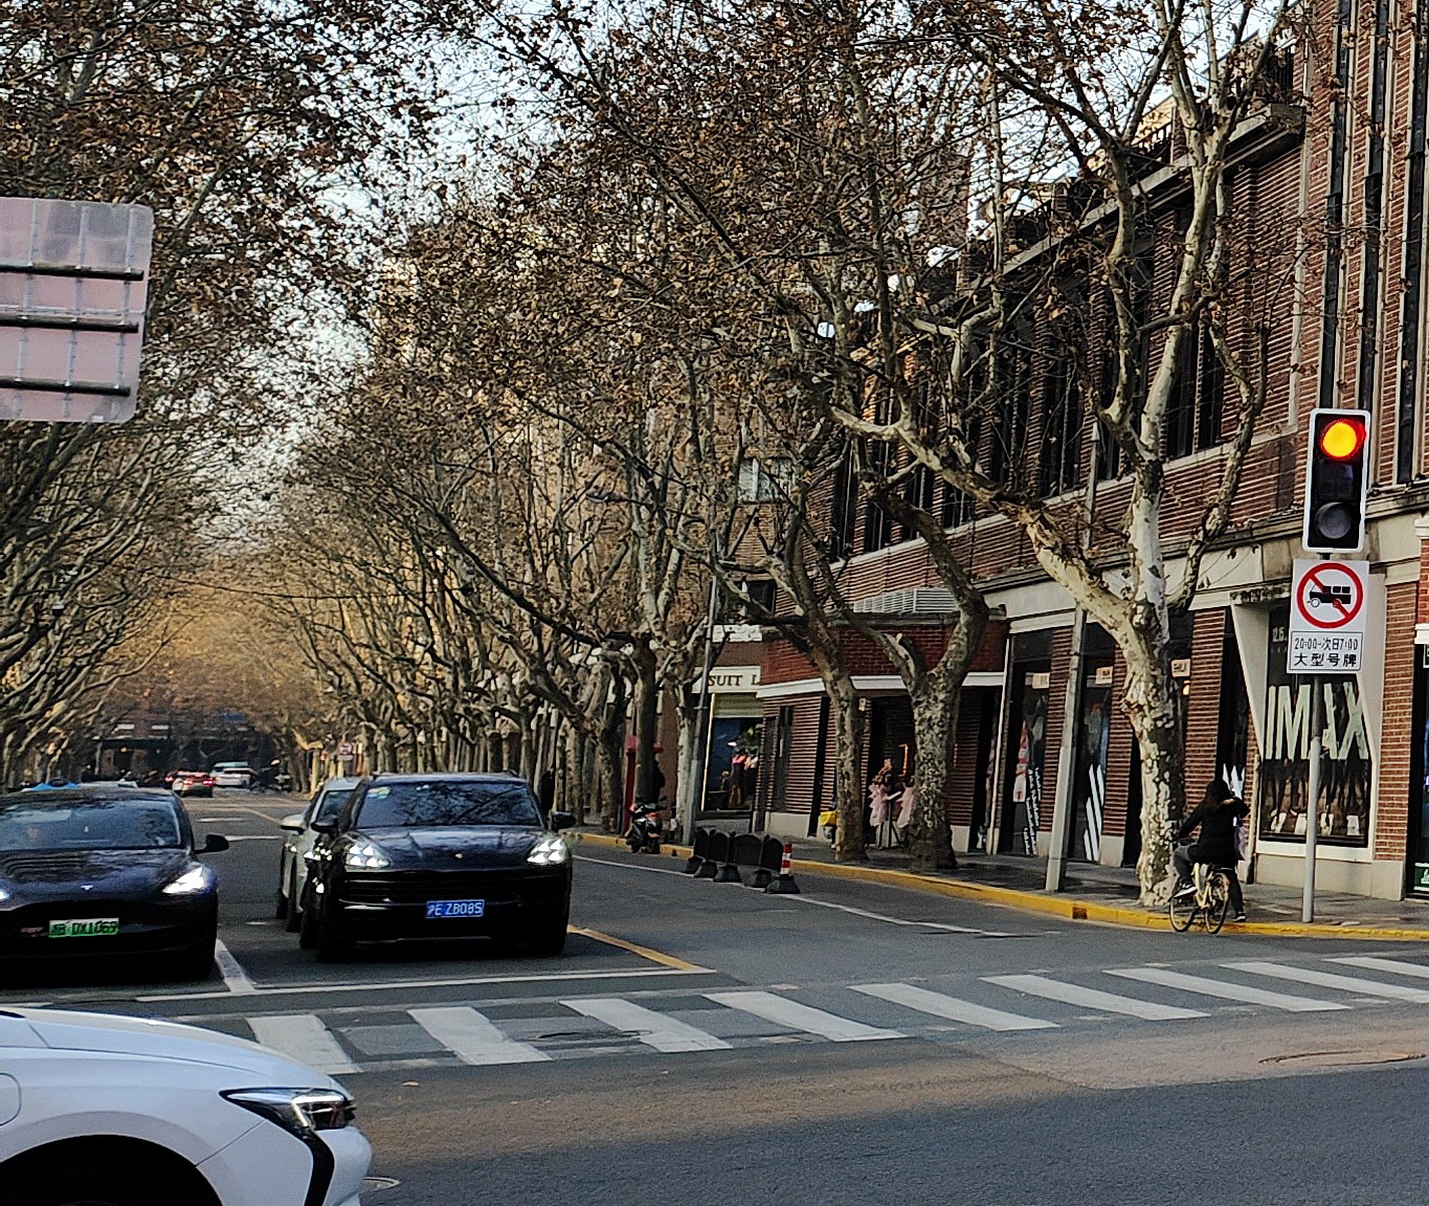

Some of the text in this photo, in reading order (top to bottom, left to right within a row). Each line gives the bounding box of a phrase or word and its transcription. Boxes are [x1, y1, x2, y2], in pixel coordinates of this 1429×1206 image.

[1294, 653, 1357, 667] 大型号牌
[709, 674, 743, 686] SUIT
[1265, 681, 1369, 760] IMAX
